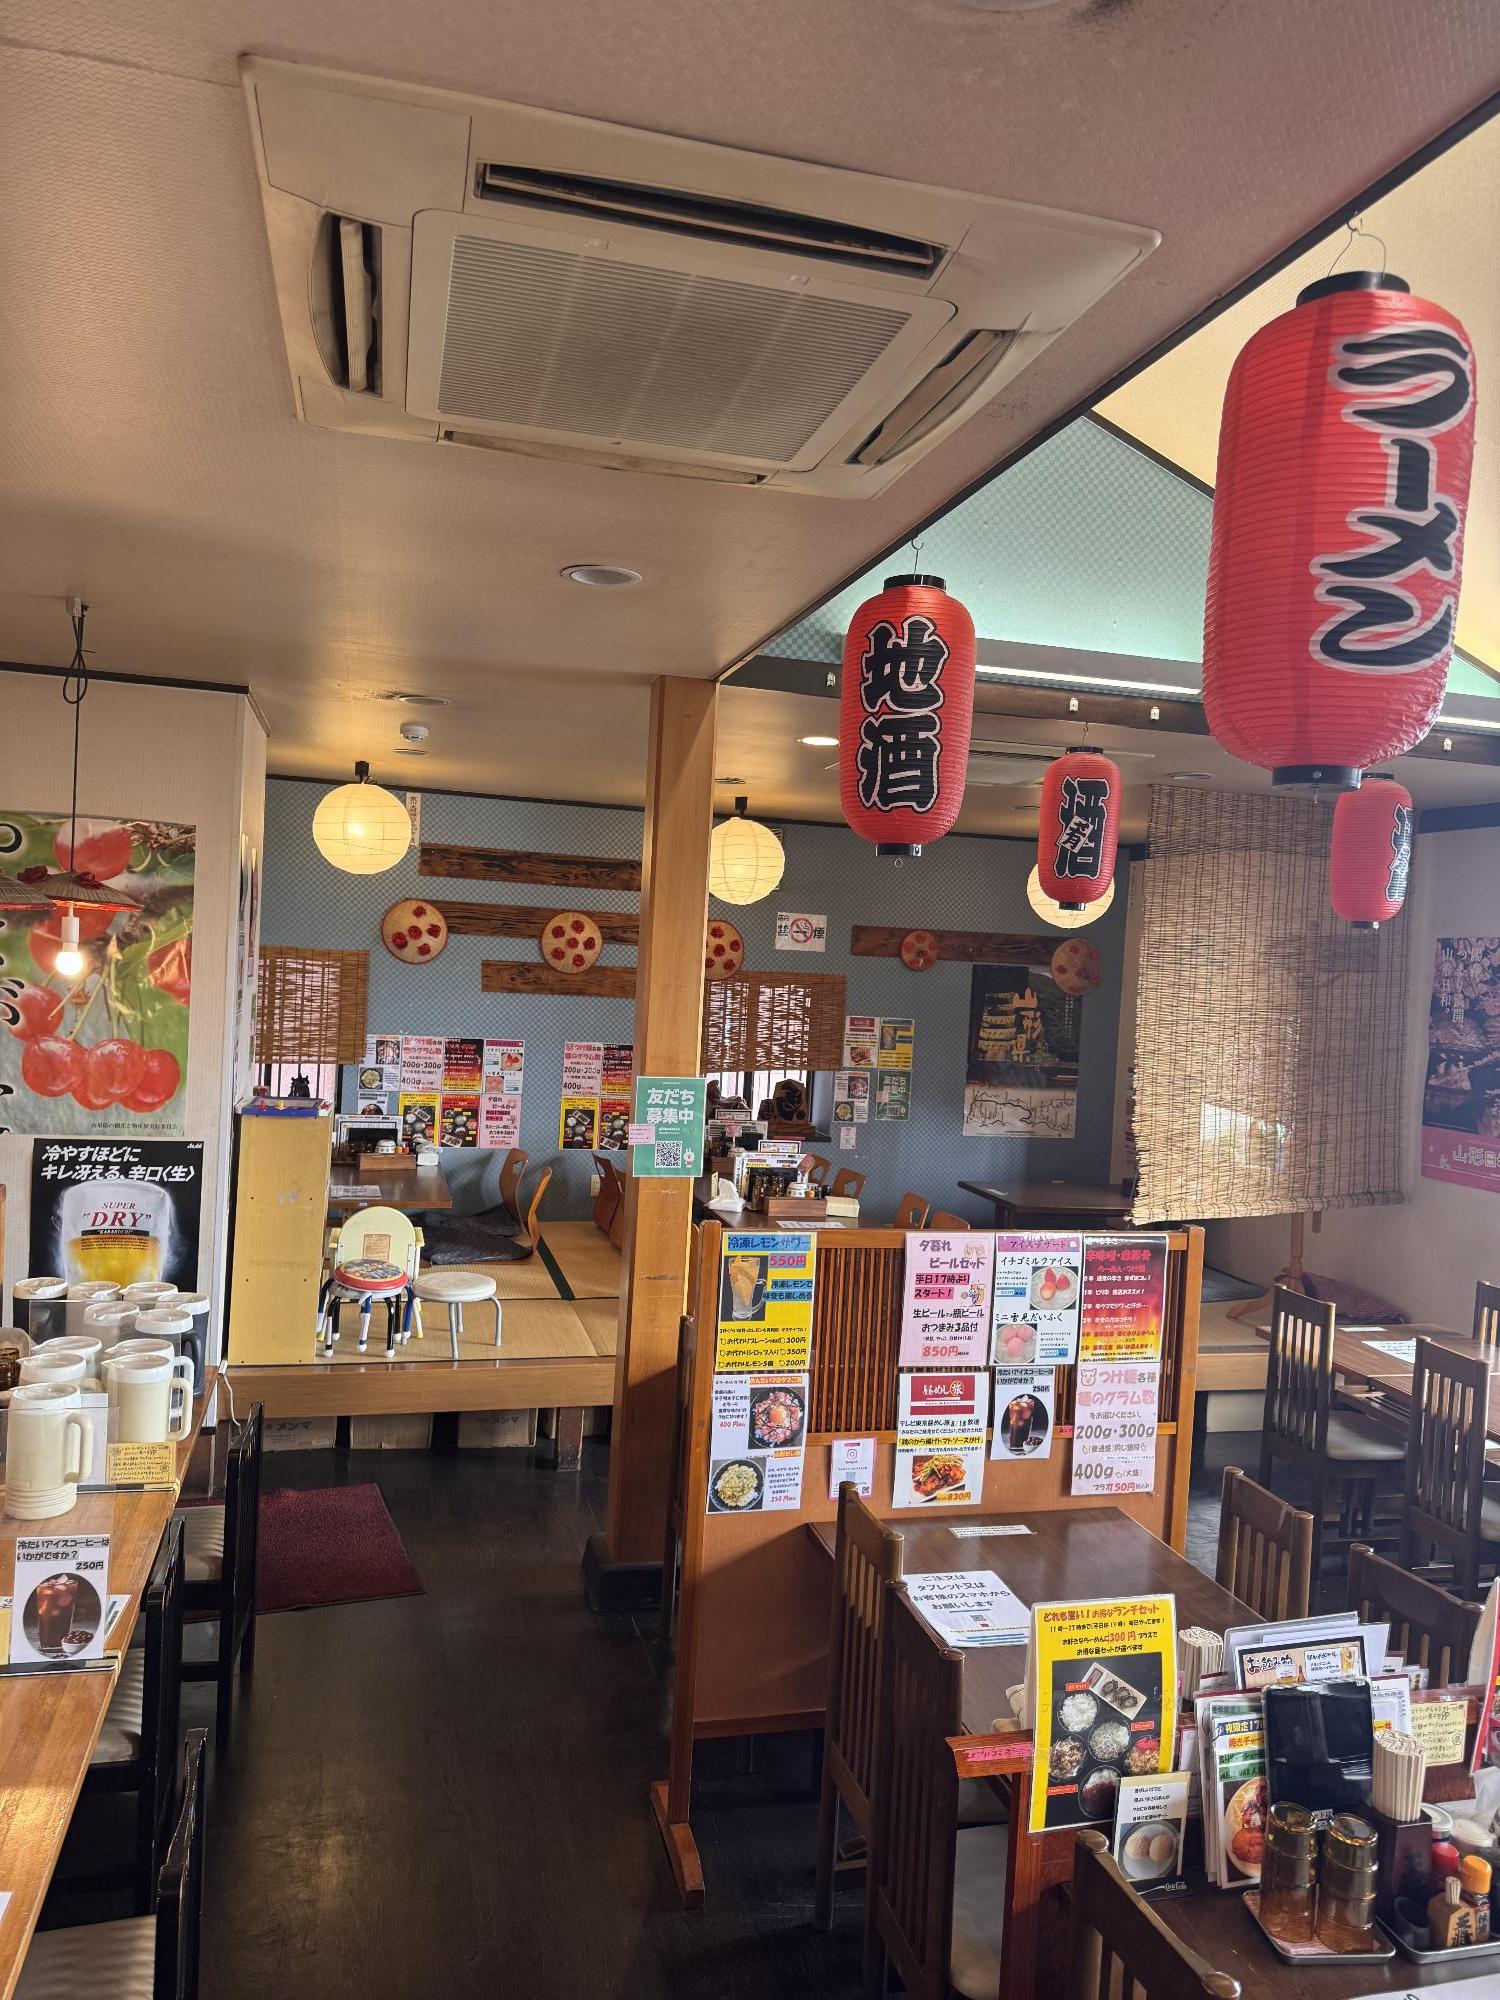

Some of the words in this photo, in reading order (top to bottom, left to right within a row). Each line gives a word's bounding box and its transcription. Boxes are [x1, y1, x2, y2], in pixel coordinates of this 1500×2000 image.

[1310, 322, 1478, 673] ラーメン
[855, 614, 950, 813] 地酒
[647, 1088, 695, 1105] 友だち
[646, 1107, 694, 1125] 募集中
[41, 1144, 142, 1162] 冷やすほどに
[1453, 1144, 1500, 1168] 山形日
[102, 1201, 137, 1210] SUPER
[728, 1236, 811, 1249] 冷凍レモンサワー
[919, 1240, 952, 1252] 夕暮れ
[768, 1255, 807, 1267] 550円
[930, 1258, 985, 1269] ビールセット
[1000, 1256, 1073, 1266] イチゴミルクアイス
[916, 1274, 970, 1284] 平日17時より
[914, 1288, 953, 1298] スタート！
[995, 1312, 1063, 1322] ミニ雪見だいふく
[921, 1323, 979, 1332] おつまみ3品付
[785, 1359, 806, 1367] 200円
[1098, 1369, 1157, 1384] つけ麺各種
[923, 1381, 965, 1397] 昼めし旅
[1077, 1389, 1156, 1407] 麺のグラム数
[1076, 1423, 1156, 1440] 200g・300g
[1074, 1463, 1114, 1480] 400g
[17, 1538, 110, 1549] 冷たいアイスコーヒーは
[75, 1561, 105, 1570] 250円
[922, 1574, 966, 1582] ご注文は
[917, 1582, 987, 1591] タブレット又は
[912, 1590, 1011, 1601] お客様のスマホから
[932, 1600, 994, 1610] お願いします
[1247, 1654, 1293, 1674] お飲み物
